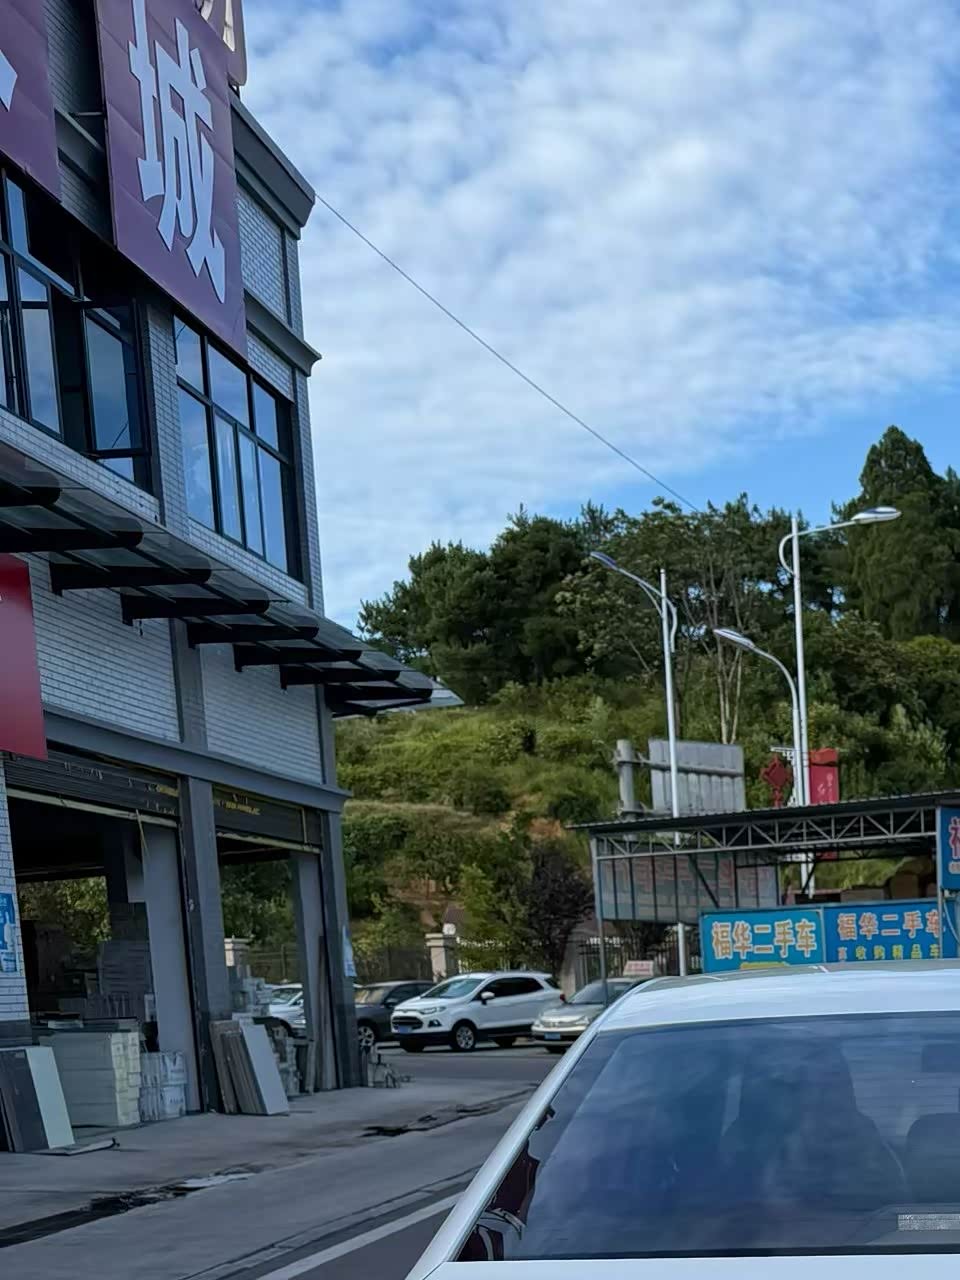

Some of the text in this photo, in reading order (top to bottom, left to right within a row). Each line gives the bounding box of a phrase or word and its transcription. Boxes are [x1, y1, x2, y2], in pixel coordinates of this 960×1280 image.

[127, 0, 226, 304] 城
[711, 918, 818, 960] 福华二手车
[837, 908, 945, 941] 福华二手车
